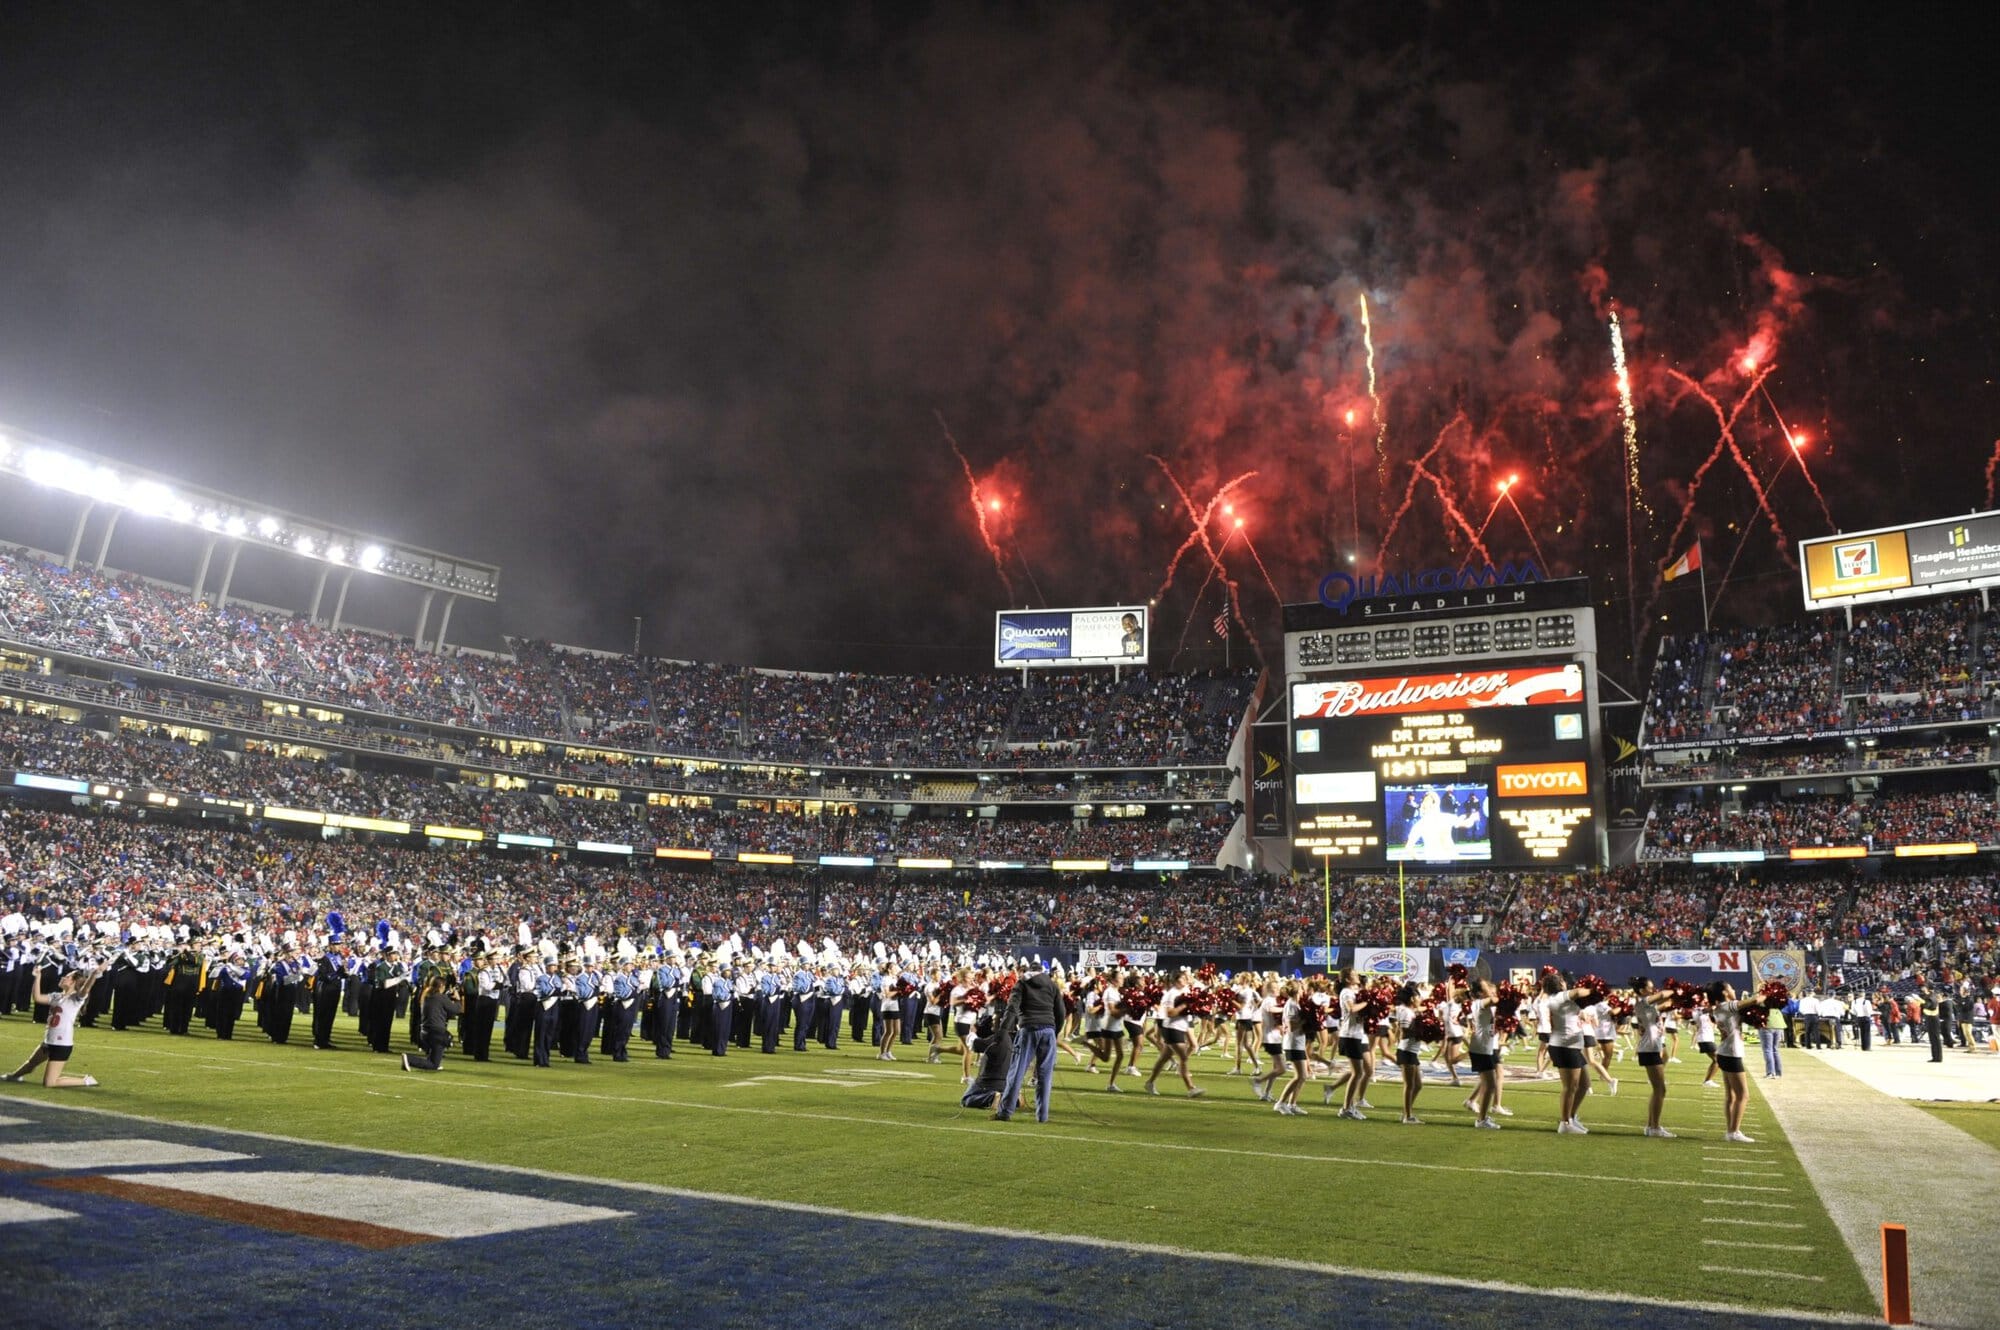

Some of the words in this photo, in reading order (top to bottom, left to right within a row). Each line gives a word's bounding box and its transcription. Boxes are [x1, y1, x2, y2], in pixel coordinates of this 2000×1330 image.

[1912, 550, 1955, 563] Imaging
[1940, 567, 1969, 575] Partner
[1970, 563, 1979, 571] in
[1319, 559, 1543, 616] QUALCOMM
[1365, 591, 1525, 614] STADIUM
[1003, 627, 1068, 643] QUALCOMM
[1320, 672, 1508, 718] Budweiser
[1447, 713, 1464, 725] TO
[1392, 729, 1413, 742] DR
[1418, 726, 1474, 741] PEPPER
[1812, 730, 1839, 738] OCATION
[1371, 741, 1451, 758] HALFTIME
[1459, 738, 1502, 754] SHOW
[1607, 765, 1642, 778] Sprint
[1254, 779, 1283, 791] Sprint
[1501, 771, 1583, 790] TOYOTA
[1085, 951, 1101, 966] A
[1718, 952, 1740, 970] N
